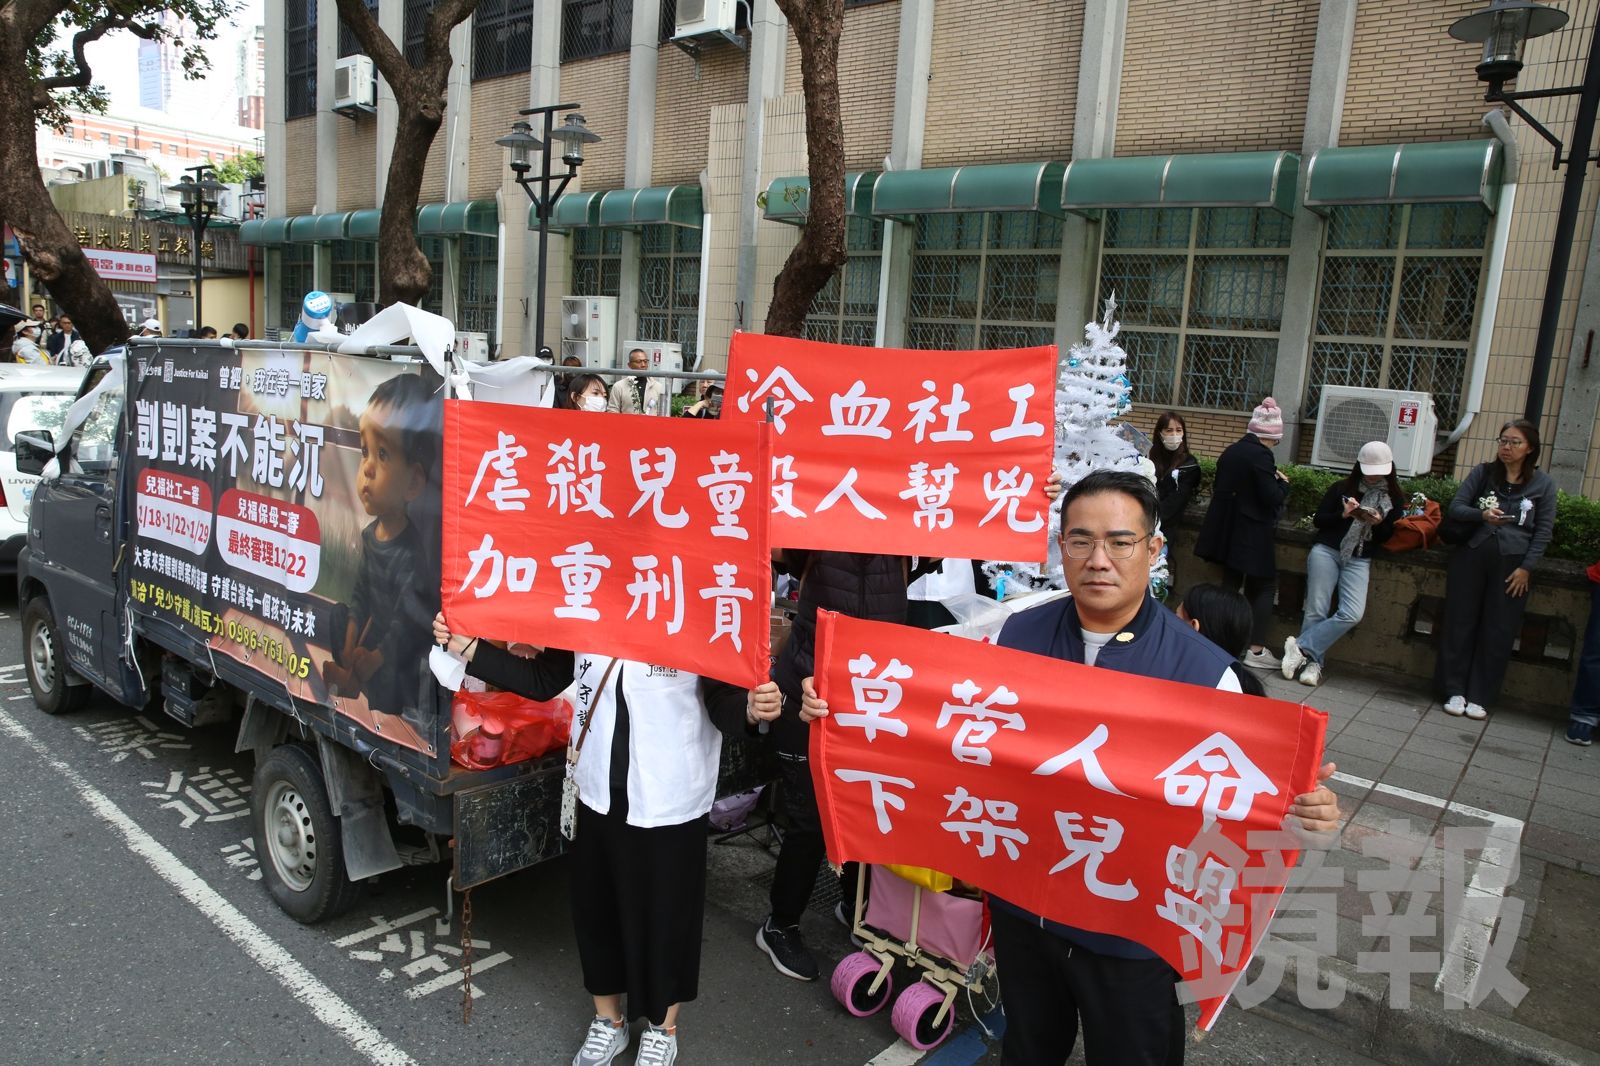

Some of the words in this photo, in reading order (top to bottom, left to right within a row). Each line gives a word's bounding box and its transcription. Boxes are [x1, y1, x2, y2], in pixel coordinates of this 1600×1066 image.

[188, 369, 196, 379] For
[737, 365, 1045, 444] 冷血社工
[135, 399, 324, 498] 剴剴案不能沉
[145, 475, 201, 506] 兒福社工一審
[464, 430, 753, 541] 虐殺兒童
[237, 497, 300, 535] 兒福保母二審
[459, 533, 754, 653] 加重刑責
[228, 620, 311, 679] 0986-76105
[833, 653, 1279, 833] 草菅人命
[833, 768, 1238, 966] 下架兒盟
